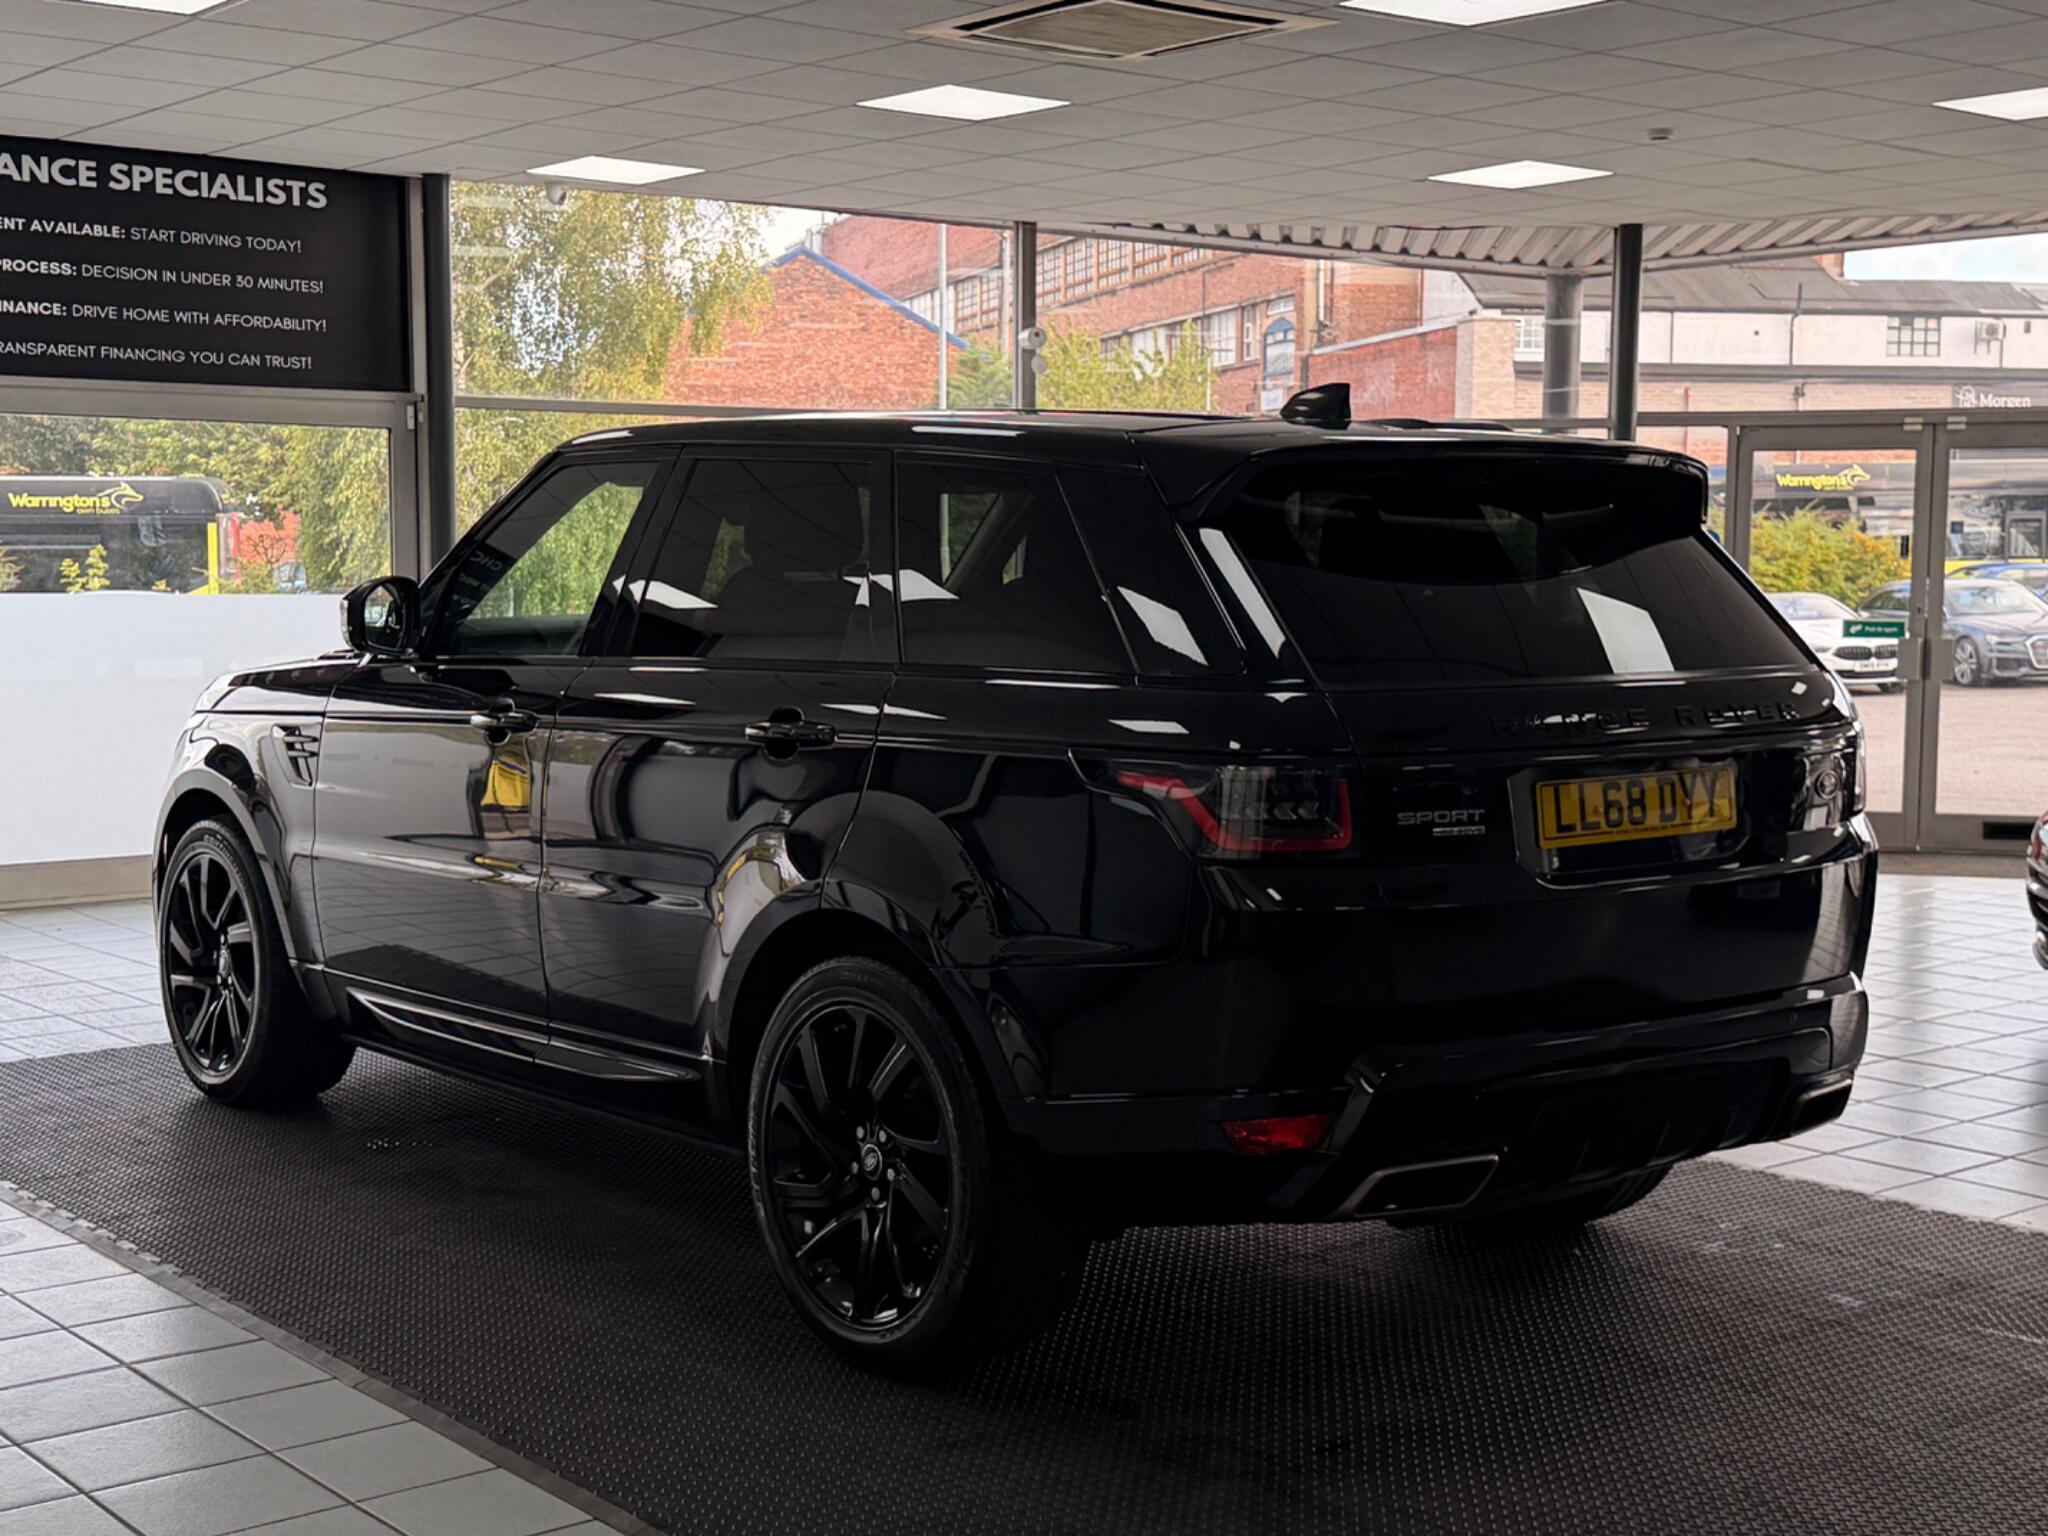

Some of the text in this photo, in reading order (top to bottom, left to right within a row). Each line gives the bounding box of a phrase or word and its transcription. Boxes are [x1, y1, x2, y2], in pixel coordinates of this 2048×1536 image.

[0, 152, 328, 209] ANCE SPECIALISTS
[30, 218, 126, 239] AVAILABLE:
[130, 227, 176, 243] START
[180, 230, 242, 248] DRIVING
[246, 236, 302, 253] TODAY!
[82, 264, 158, 282] DECISION
[162, 270, 177, 283] IN
[181, 271, 232, 287] UNDER
[235, 274, 253, 289] 30
[257, 276, 324, 294] MINUTES!
[72, 304, 118, 320] DRIVE
[122, 307, 170, 322] HOME
[174, 310, 209, 326] WITH
[213, 313, 327, 332] AFFORDABILITY!
[101, 346, 185, 363] FINANCING
[189, 351, 224, 365] YOU
[228, 353, 260, 367] CAN
[264, 355, 312, 370] TRUST!
[1398, 809, 1485, 824] SPORT
[1553, 771, 1719, 834] LL68 DYY
